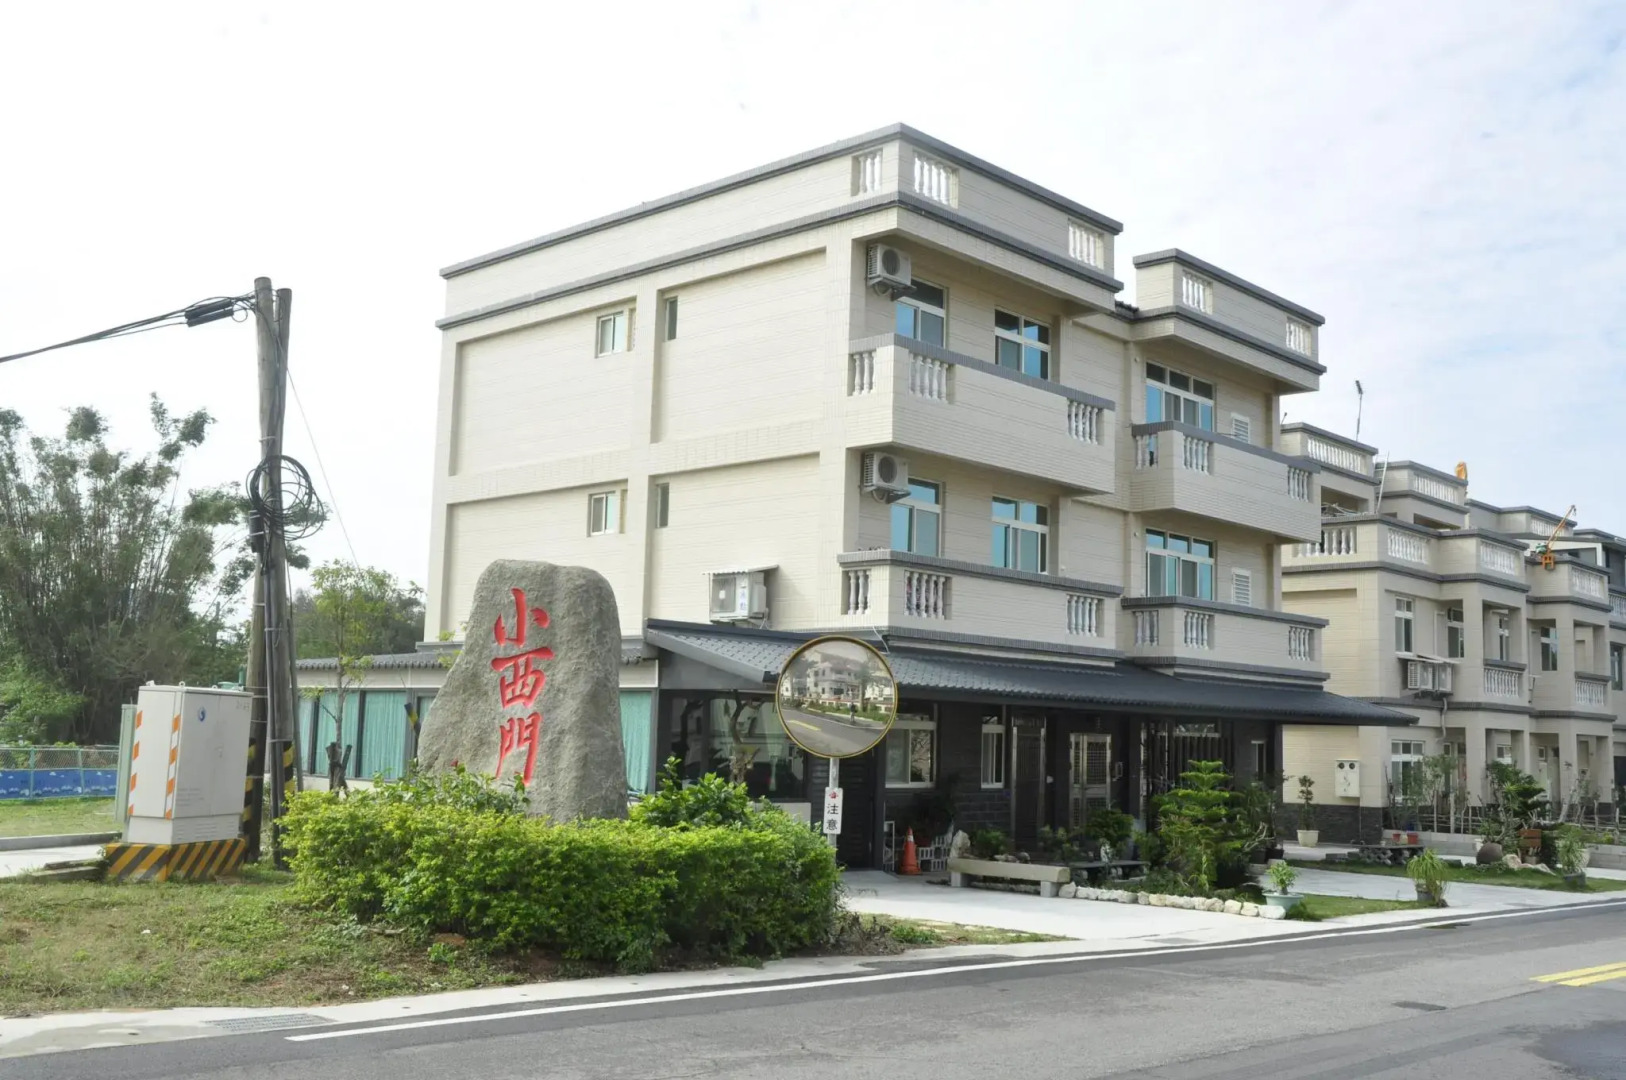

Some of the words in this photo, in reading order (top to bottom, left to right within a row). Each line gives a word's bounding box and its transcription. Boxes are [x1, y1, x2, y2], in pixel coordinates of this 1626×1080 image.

[491, 587, 554, 786] 小西門
[826, 803, 839, 831] 注意
